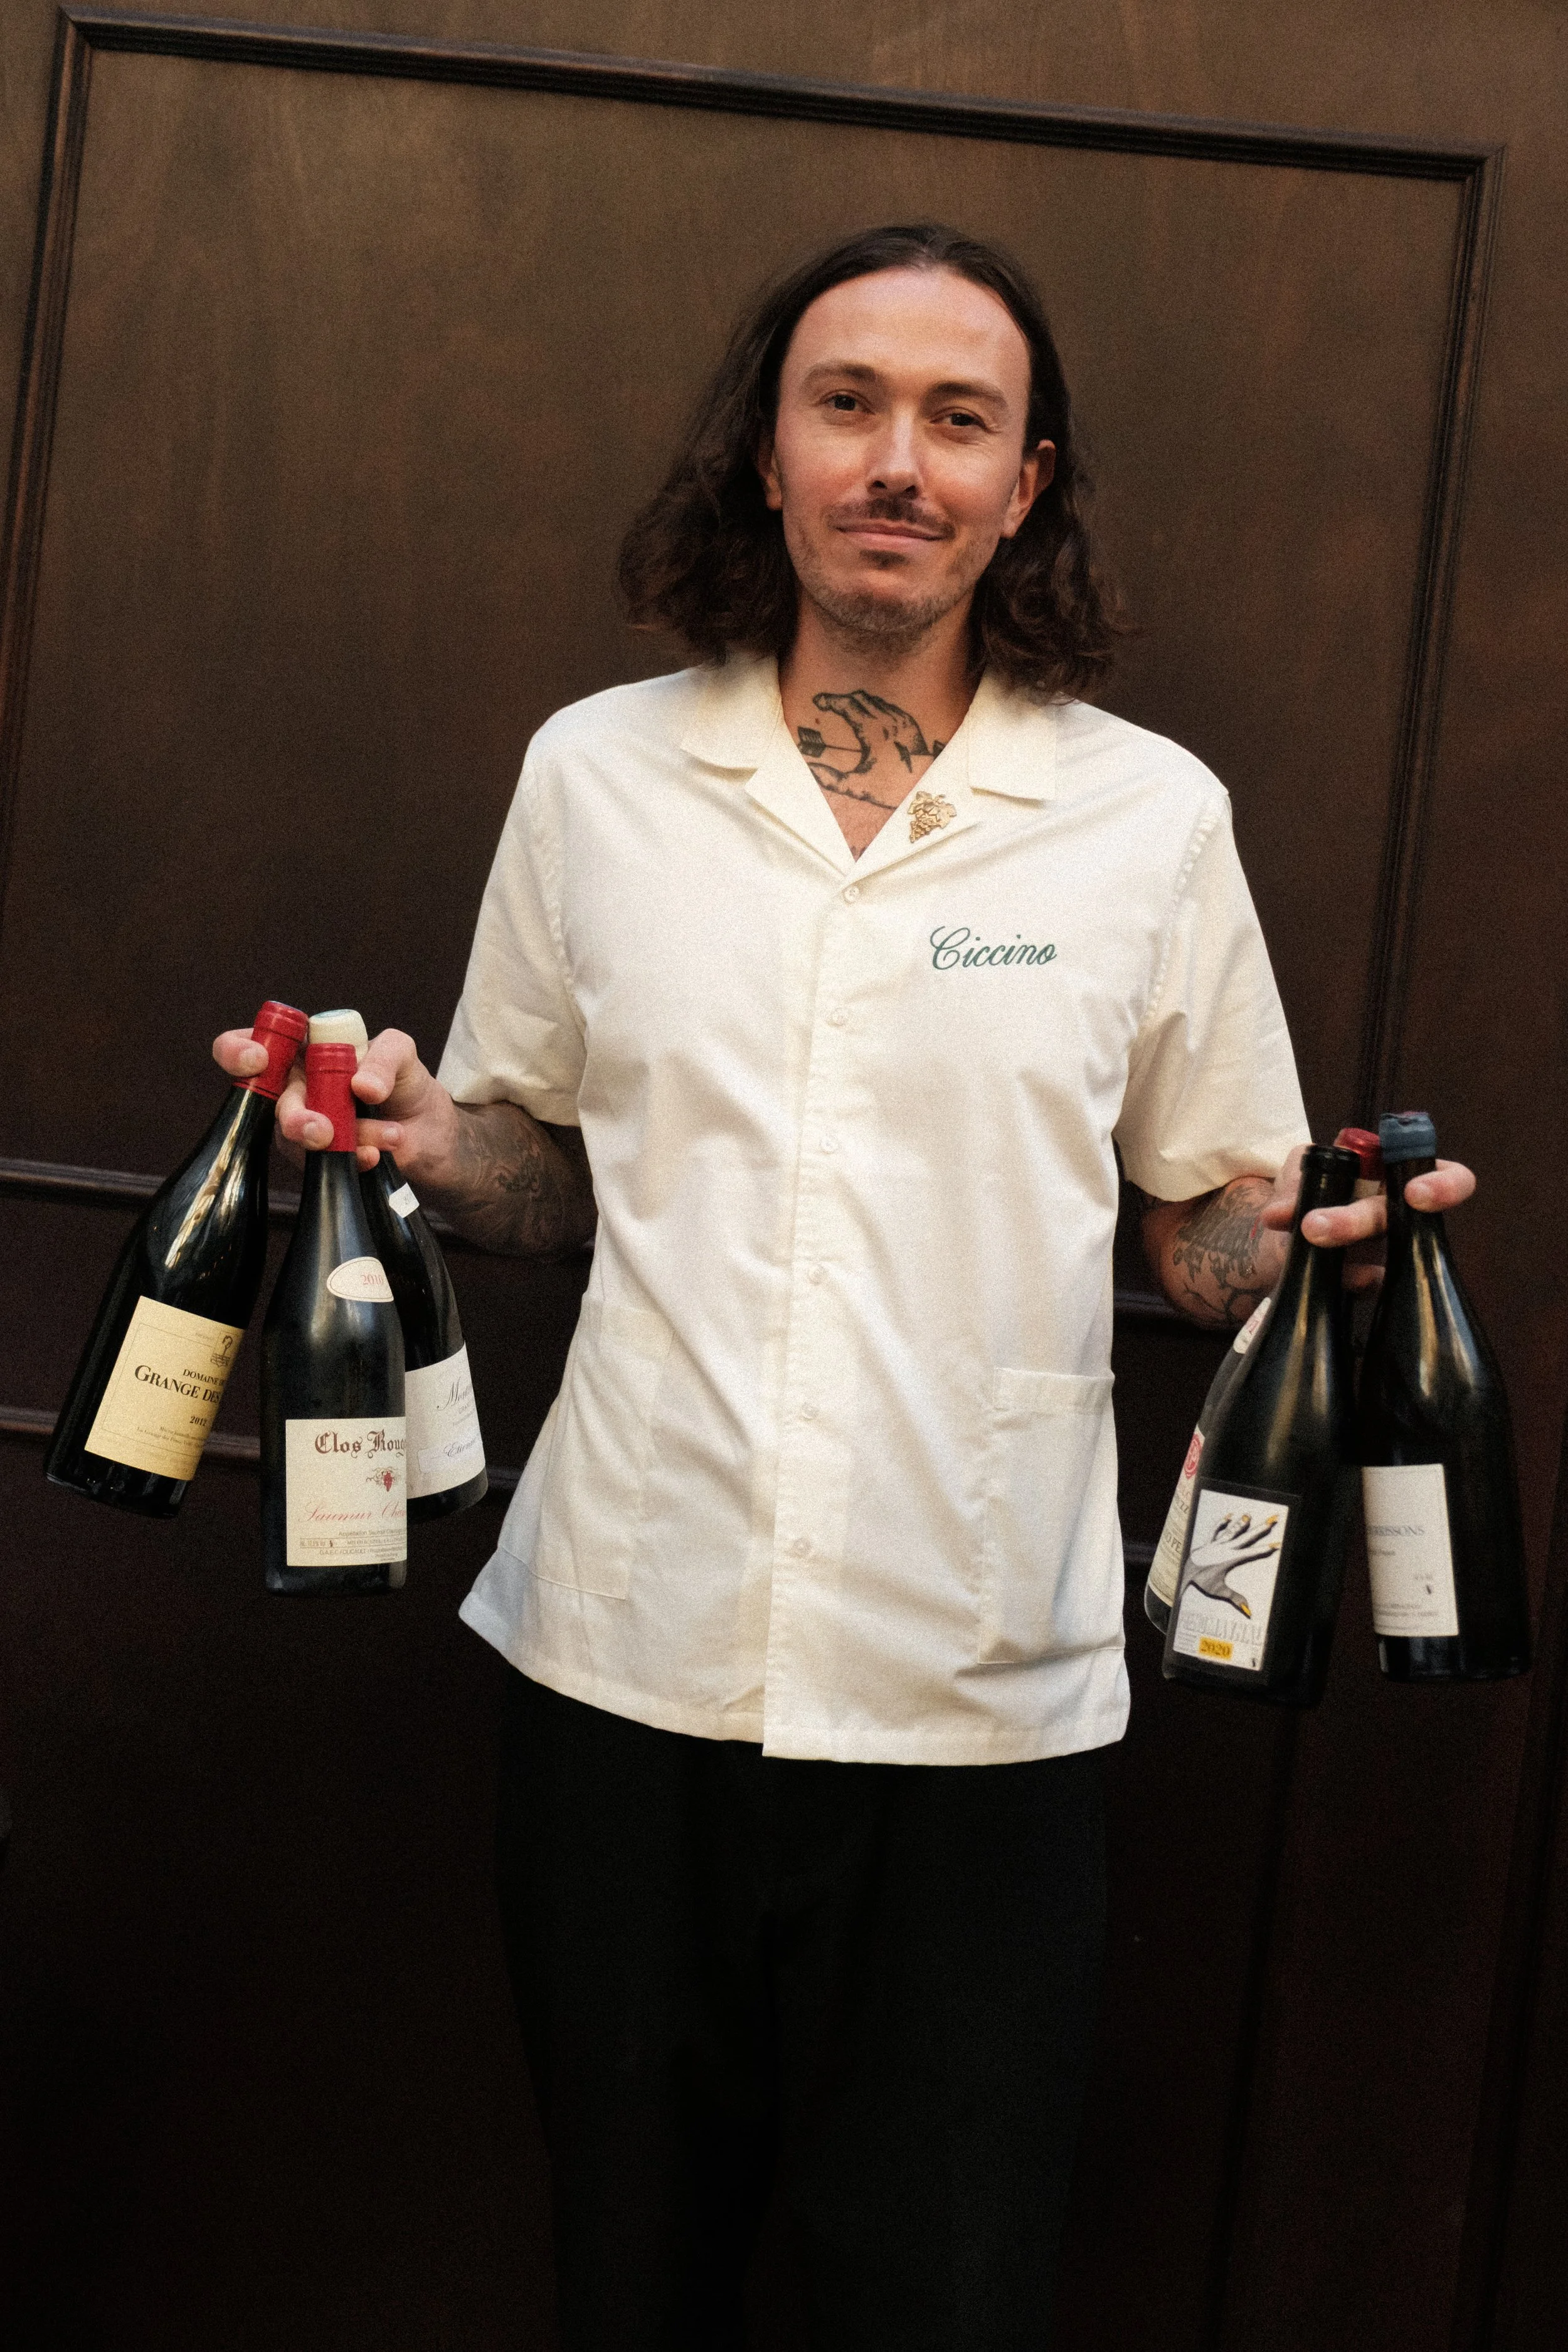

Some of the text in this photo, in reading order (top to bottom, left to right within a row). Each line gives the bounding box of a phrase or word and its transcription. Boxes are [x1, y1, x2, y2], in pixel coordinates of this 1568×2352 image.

[930, 926, 1057, 970] Ciccino
[134, 1364, 221, 1404] GRANGE DES
[183, 1368, 219, 1385] DOMAINE
[314, 1429, 406, 1459] Clos Roug
[1200, 1640, 1231, 1657] 2020
